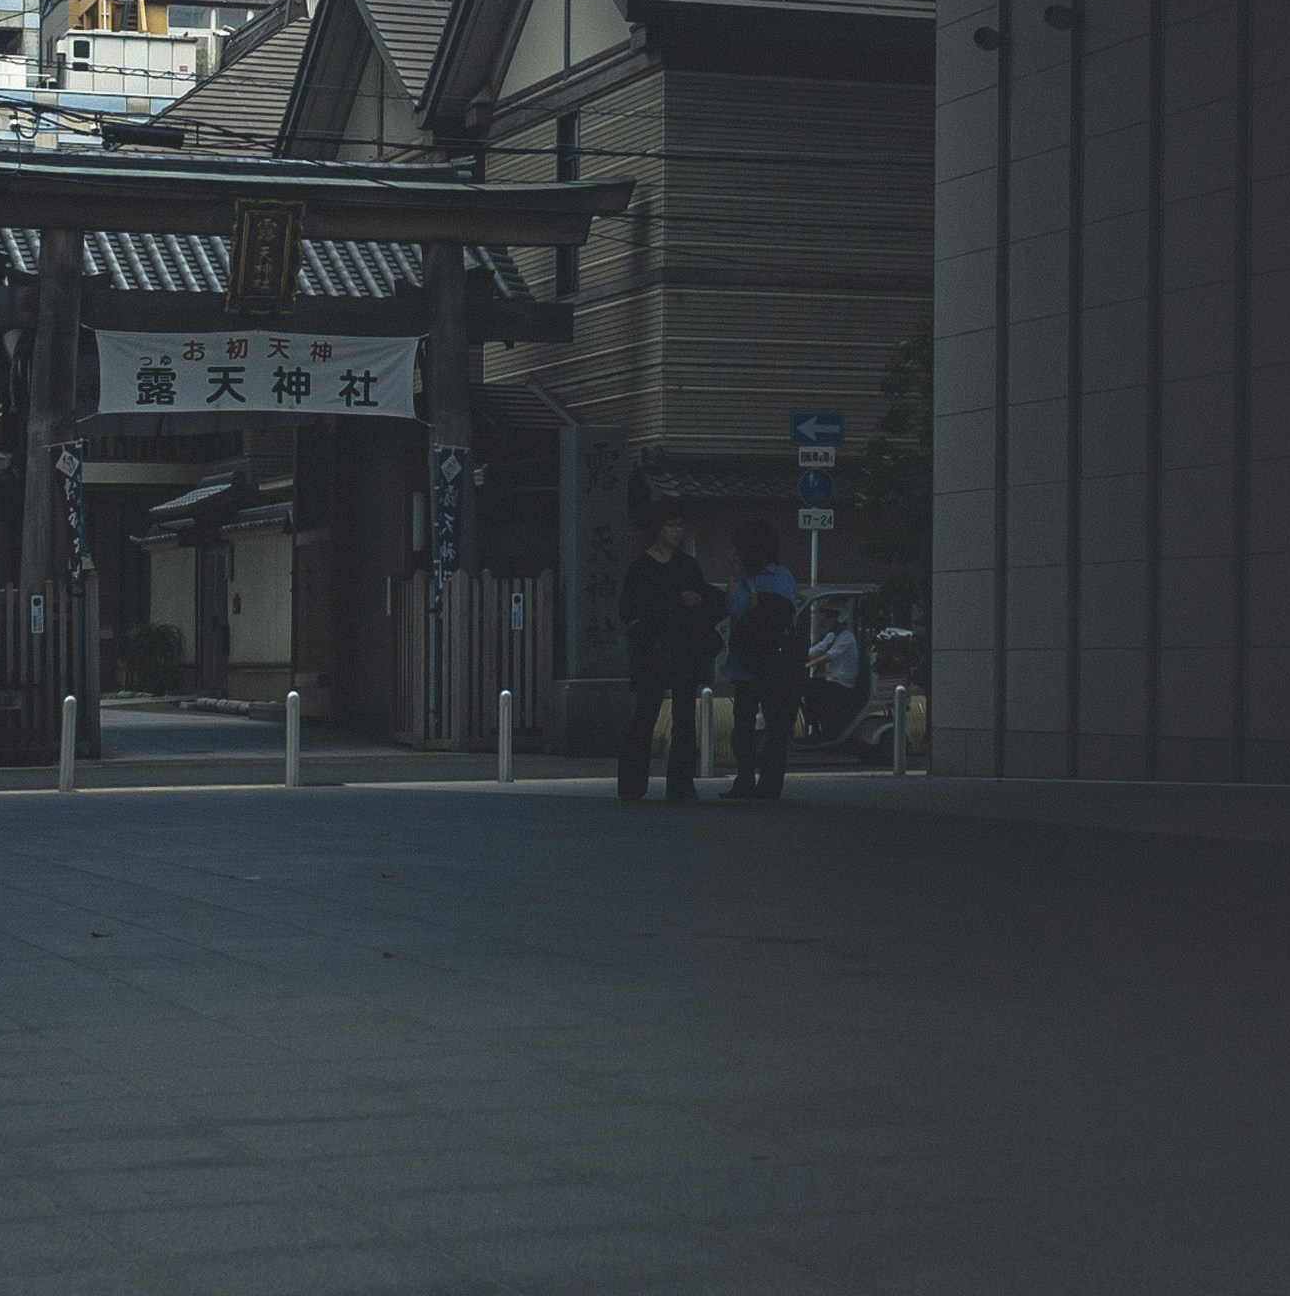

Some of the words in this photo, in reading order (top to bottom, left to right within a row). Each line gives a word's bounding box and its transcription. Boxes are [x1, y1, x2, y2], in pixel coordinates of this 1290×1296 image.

[139, 354, 172, 366] つゆ
[182, 337, 333, 363] お初天神
[136, 366, 379, 407] 露天神社
